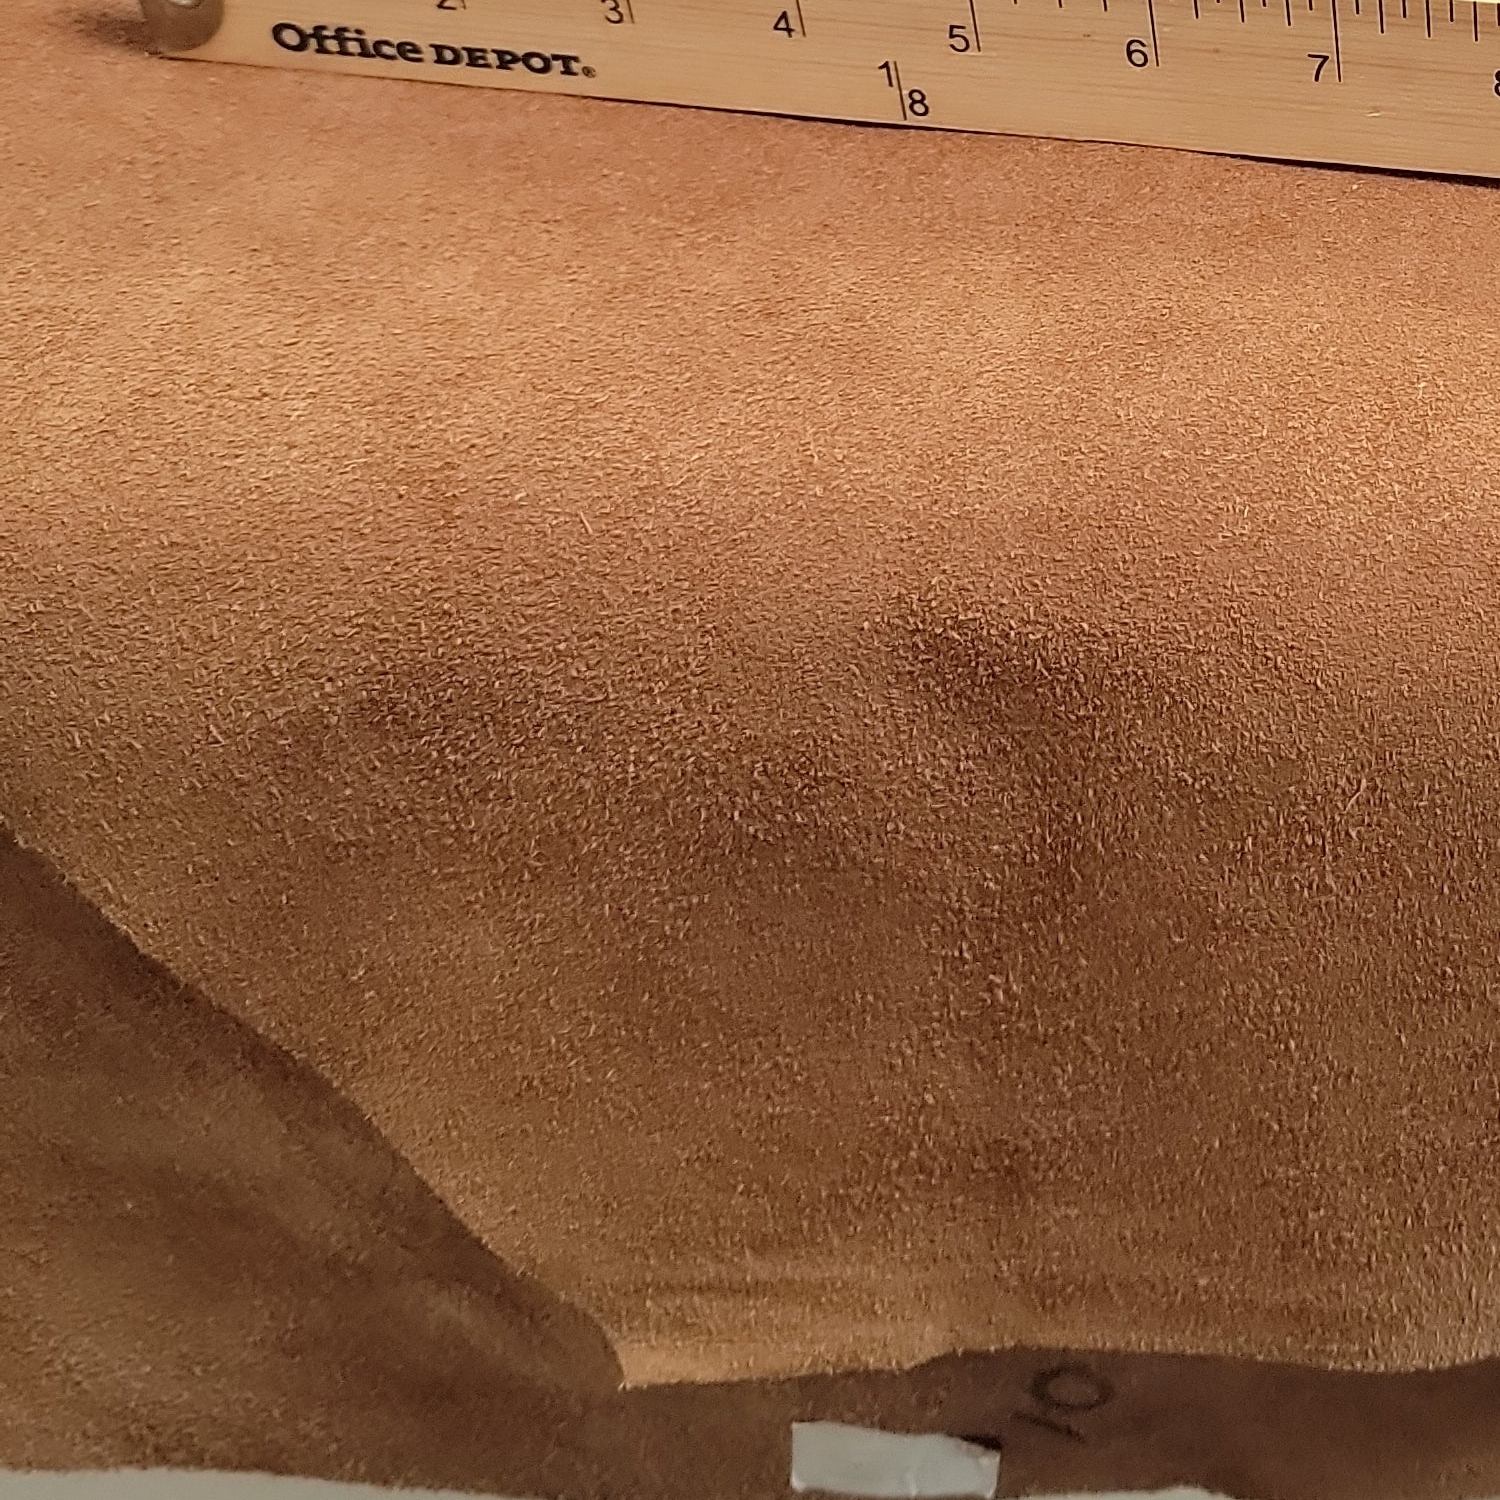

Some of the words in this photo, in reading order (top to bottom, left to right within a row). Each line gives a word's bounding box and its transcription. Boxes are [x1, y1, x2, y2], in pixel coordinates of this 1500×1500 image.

[271, 22, 424, 63] Office
[773, 11, 795, 38] 4
[948, 25, 971, 53] 5
[1126, 39, 1149, 69] 6
[1307, 54, 1331, 83] 7
